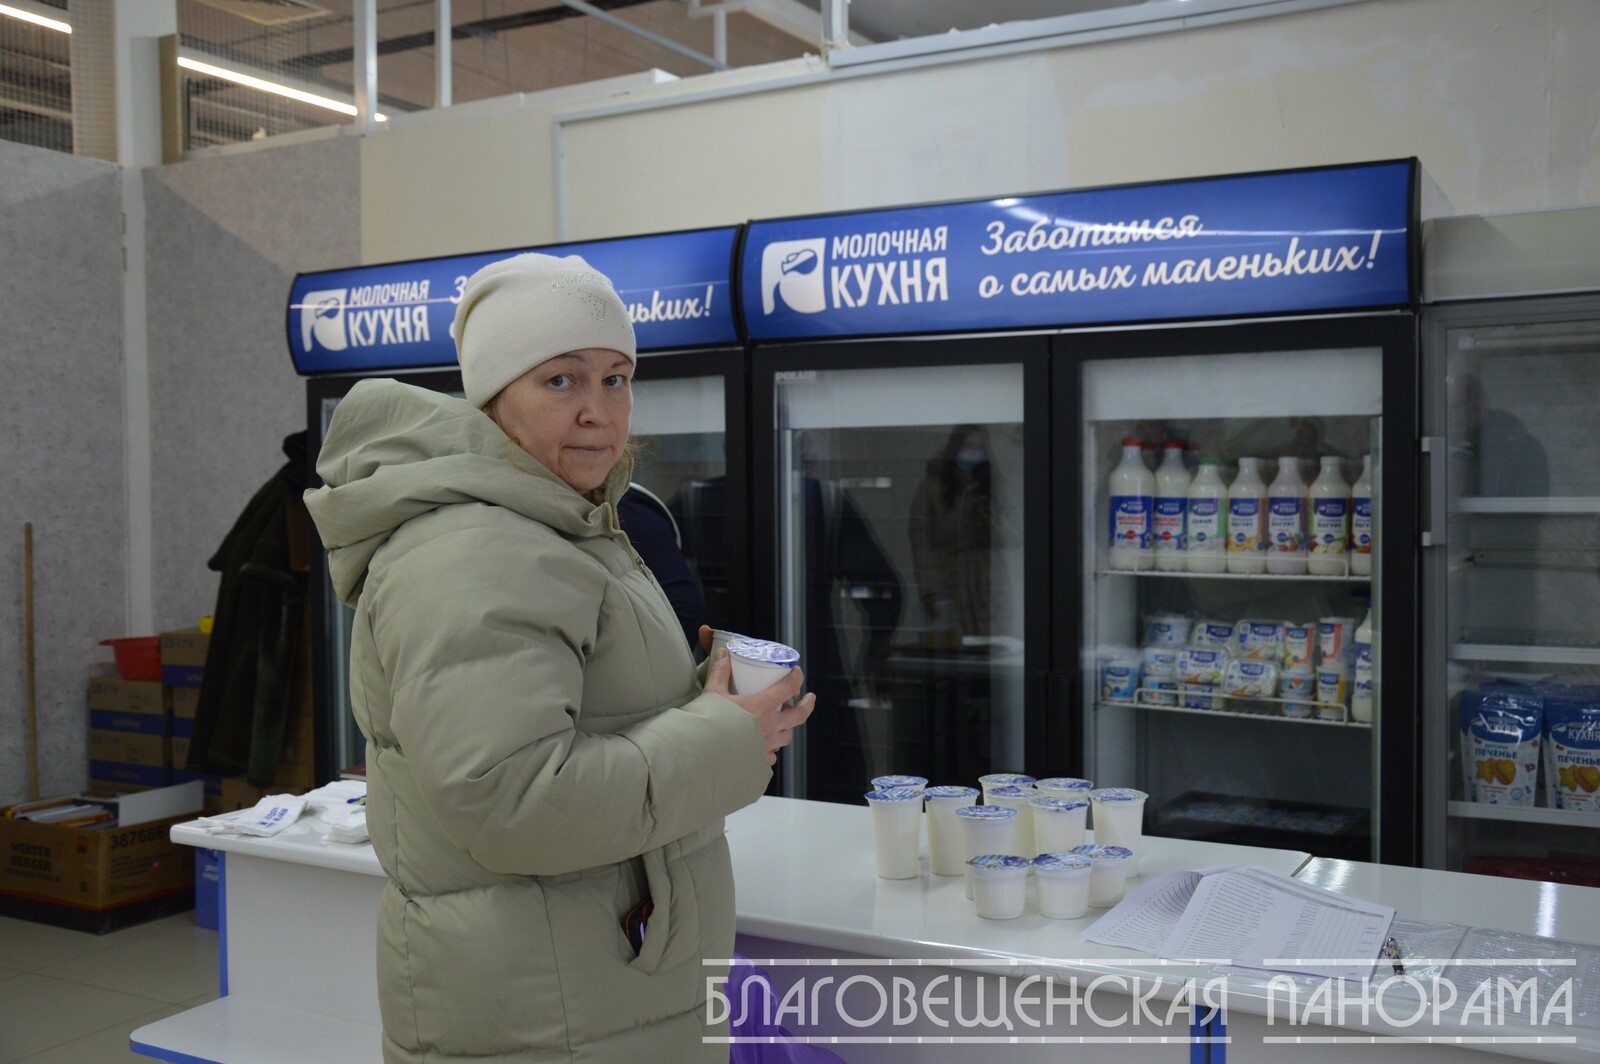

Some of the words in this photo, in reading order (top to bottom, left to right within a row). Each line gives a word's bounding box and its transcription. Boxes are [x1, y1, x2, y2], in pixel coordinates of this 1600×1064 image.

[831, 226, 948, 260] МОЛОЧНАЯ
[980, 214, 1203, 255] Заботимся
[978, 275, 1003, 298] о
[1010, 264, 1137, 296] самых
[1141, 229, 1382, 287] маленьких!
[349, 280, 430, 307] МОЛОЧНАЯ
[831, 257, 948, 309] КУХНЯ
[348, 305, 430, 347] КУХНЯ
[775, 371, 816, 380] POLAIR
[1475, 748, 1518, 759] ПЕЧЕНЬЕ
[1557, 755, 1600, 766] ПЕЧЕНЬЕ
